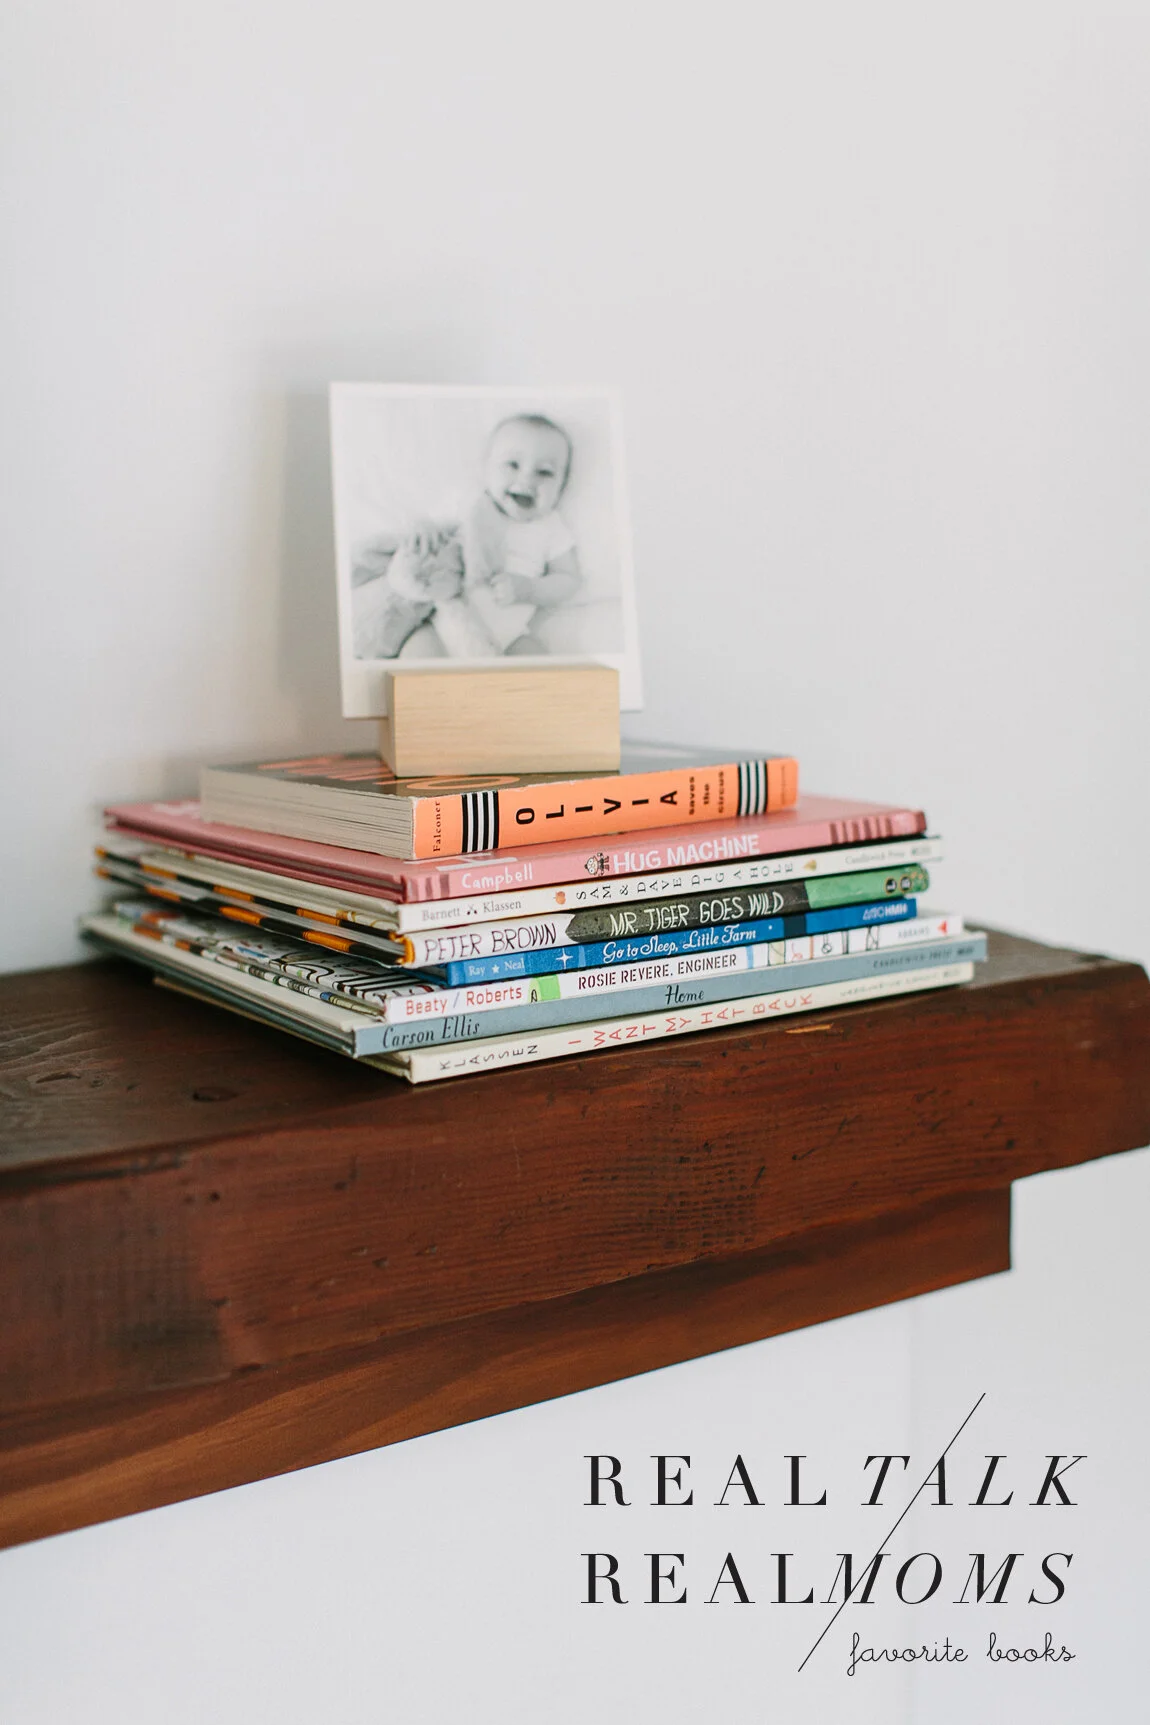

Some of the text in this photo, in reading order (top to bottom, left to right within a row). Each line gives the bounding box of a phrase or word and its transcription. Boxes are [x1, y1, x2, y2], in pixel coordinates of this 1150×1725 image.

[515, 789, 678, 825] OLIVIA
[432, 801, 442, 852] Falconer
[612, 834, 760, 873] HUG MACHINE
[461, 863, 533, 891] Campbell
[576, 862, 793, 900] SAM & DAVE DIG A HOLE
[421, 900, 522, 922] Barnett Klassen
[609, 891, 784, 937] MR. TIGER GOES WILD
[424, 922, 558, 962] PETER BROWN
[602, 923, 757, 963] Go to Sleep, Little Farm
[467, 959, 525, 977] Ray Neal
[578, 971, 617, 990] ROSIE
[677, 953, 737, 975] ENGINEER
[405, 997, 448, 1016] Beaty
[466, 986, 522, 1006] Roberts
[664, 984, 705, 1005] Home
[382, 1015, 480, 1049] Carson Ellis
[593, 1025, 656, 1047] WANT
[665, 1017, 692, 1032] MY
[701, 1007, 745, 1025] HAT
[753, 992, 813, 1014] BACK
[439, 1044, 539, 1070] KLASSEN
